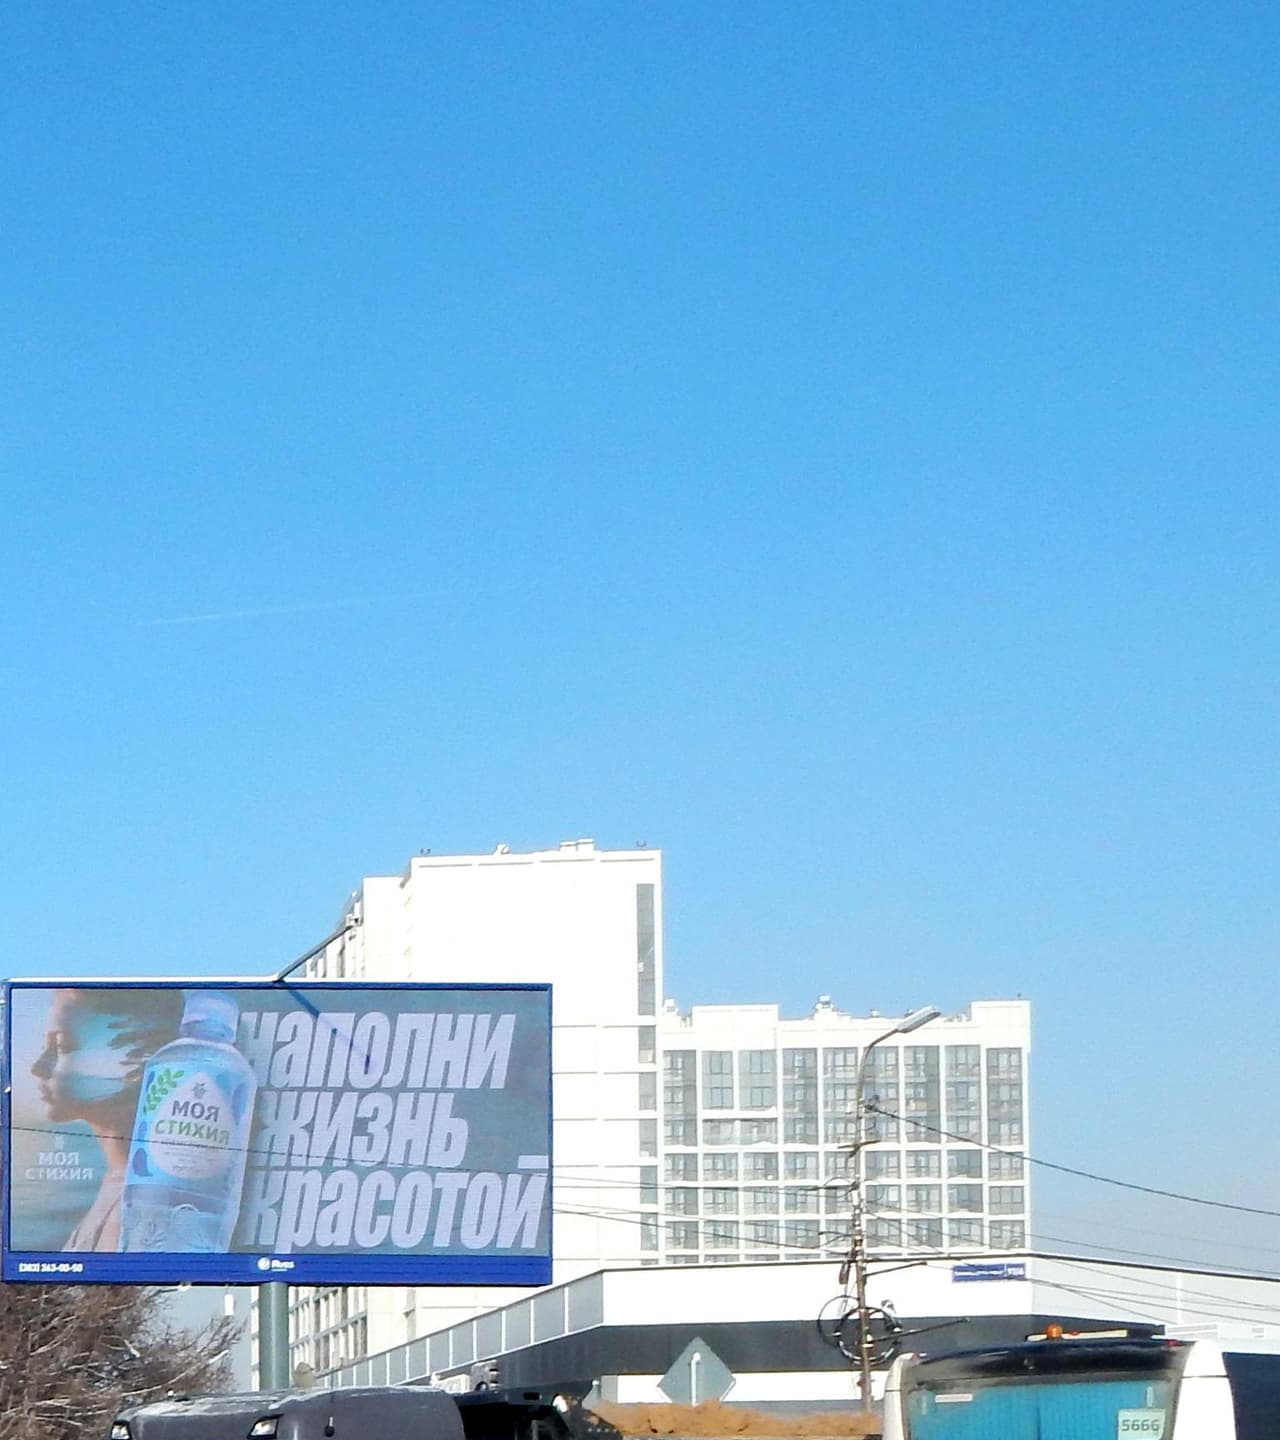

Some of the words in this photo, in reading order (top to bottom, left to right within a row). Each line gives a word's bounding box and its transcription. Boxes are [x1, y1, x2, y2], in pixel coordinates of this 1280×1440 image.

[172, 1101, 220, 1122] МОЯ
[155, 1120, 230, 1145] СТИХИЯ
[39, 1152, 80, 1166] МОЯ
[25, 1167, 93, 1181] СТИХИЯ
[1121, 1419, 1160, 1431] 5666
